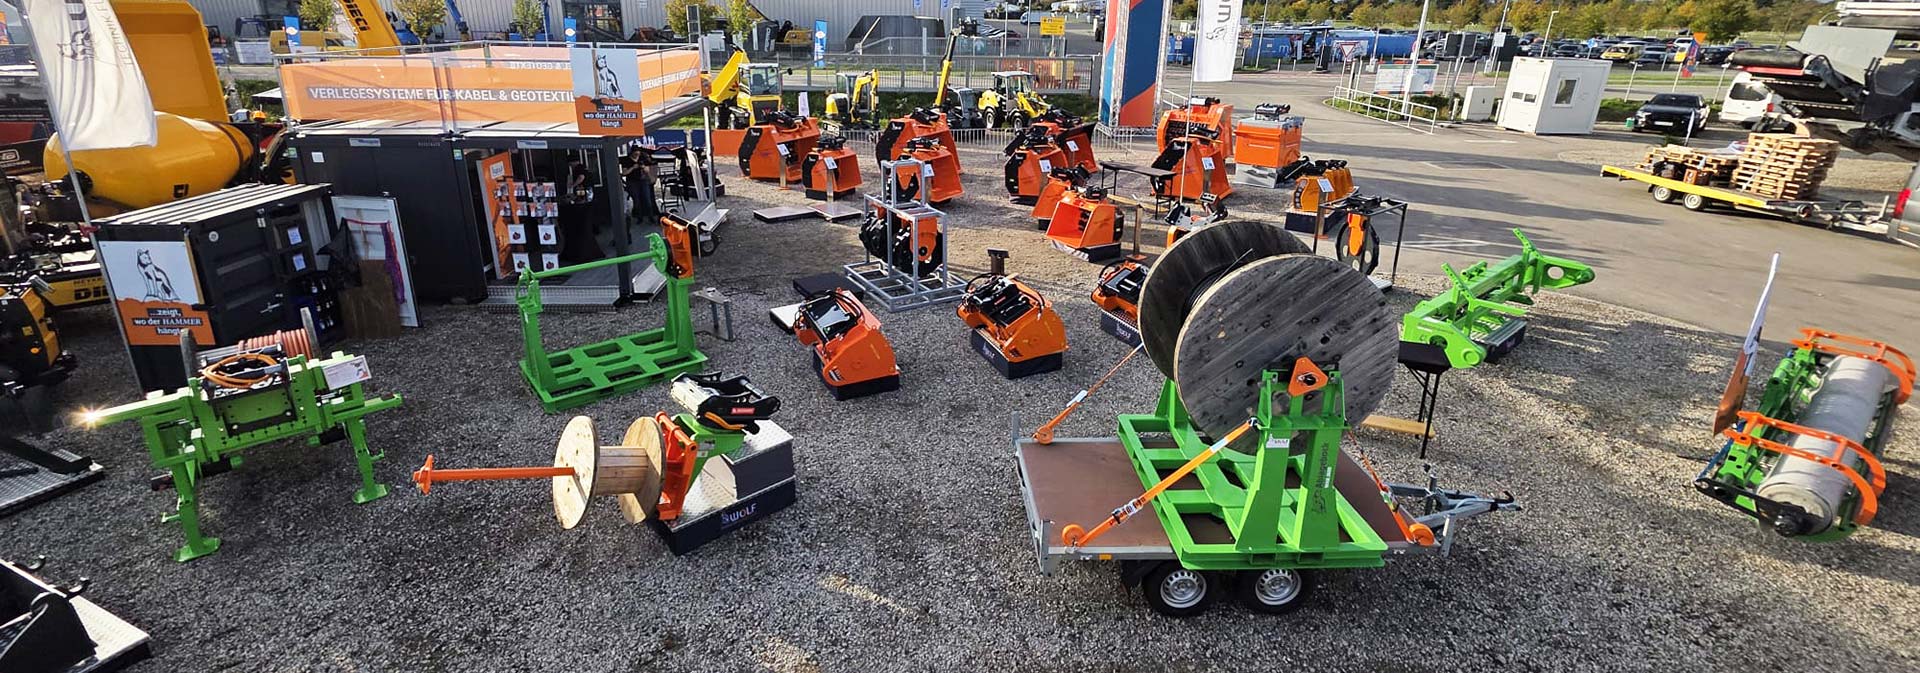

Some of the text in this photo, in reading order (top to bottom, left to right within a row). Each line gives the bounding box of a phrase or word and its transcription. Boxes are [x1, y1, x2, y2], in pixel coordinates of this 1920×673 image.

[310, 87, 424, 101] VERLEGESYSTEME
[455, 89, 496, 102] KABEL
[498, 90, 508, 102] &
